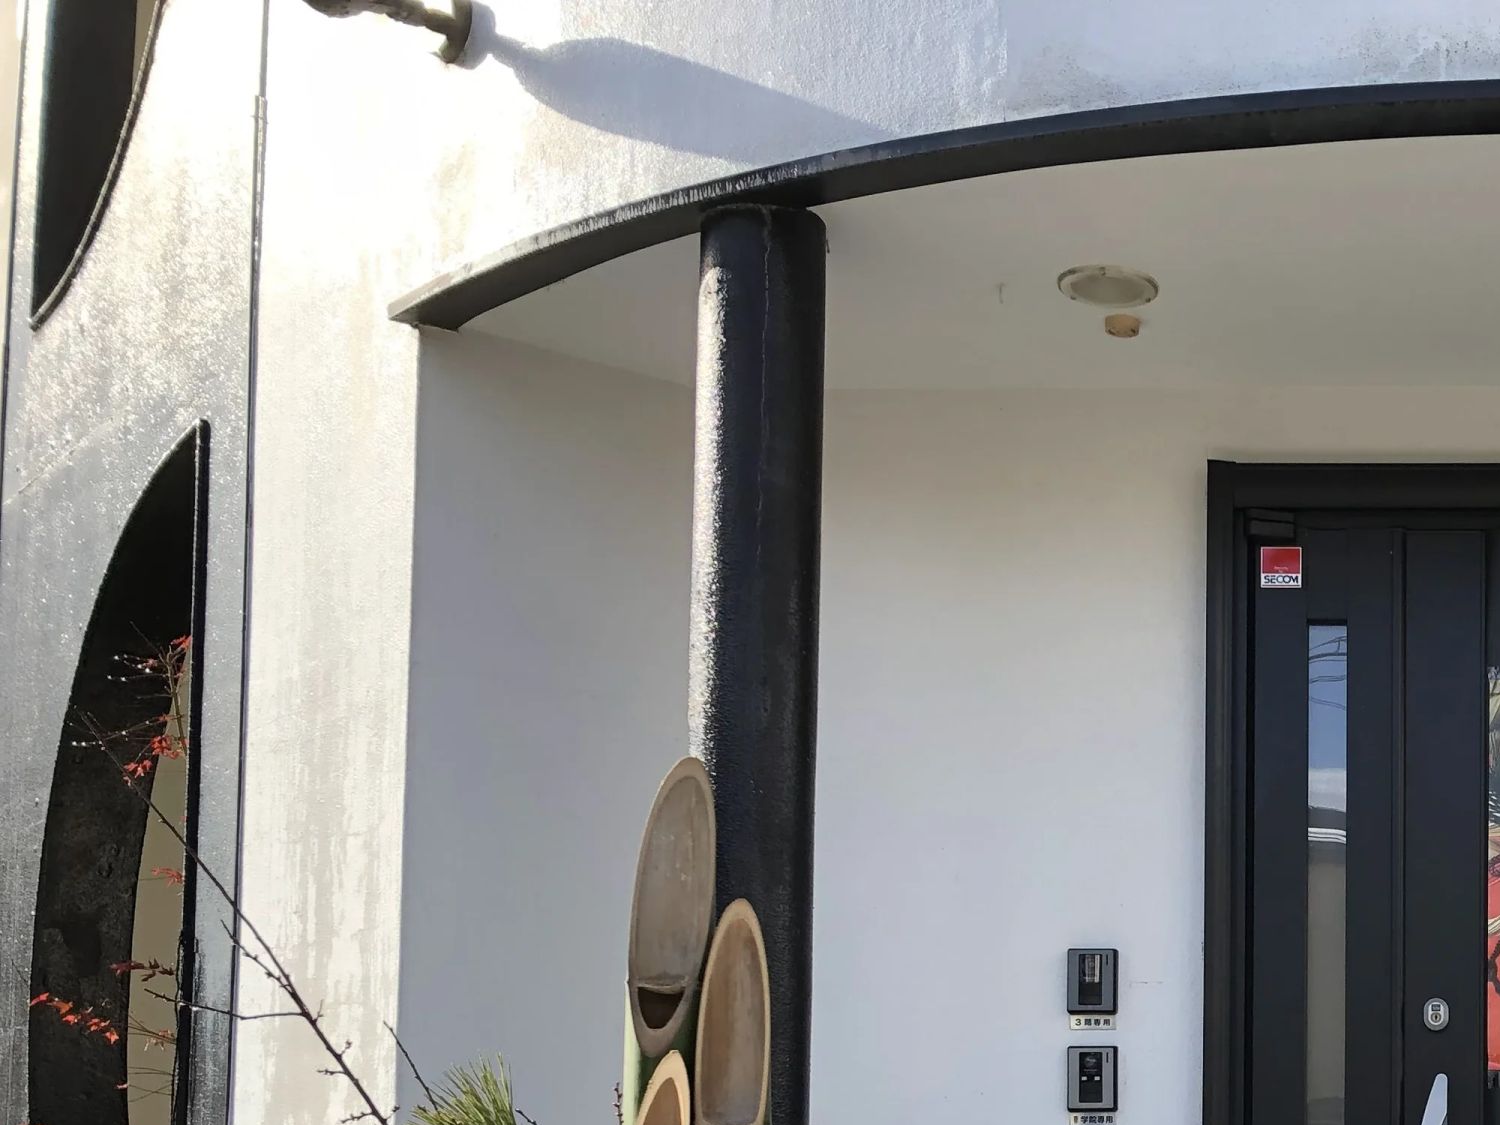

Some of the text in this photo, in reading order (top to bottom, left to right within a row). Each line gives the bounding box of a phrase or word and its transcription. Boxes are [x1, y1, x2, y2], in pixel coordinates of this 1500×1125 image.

[1264, 574, 1299, 584] SECOM
[1075, 1018, 1111, 1026] 3階専用
